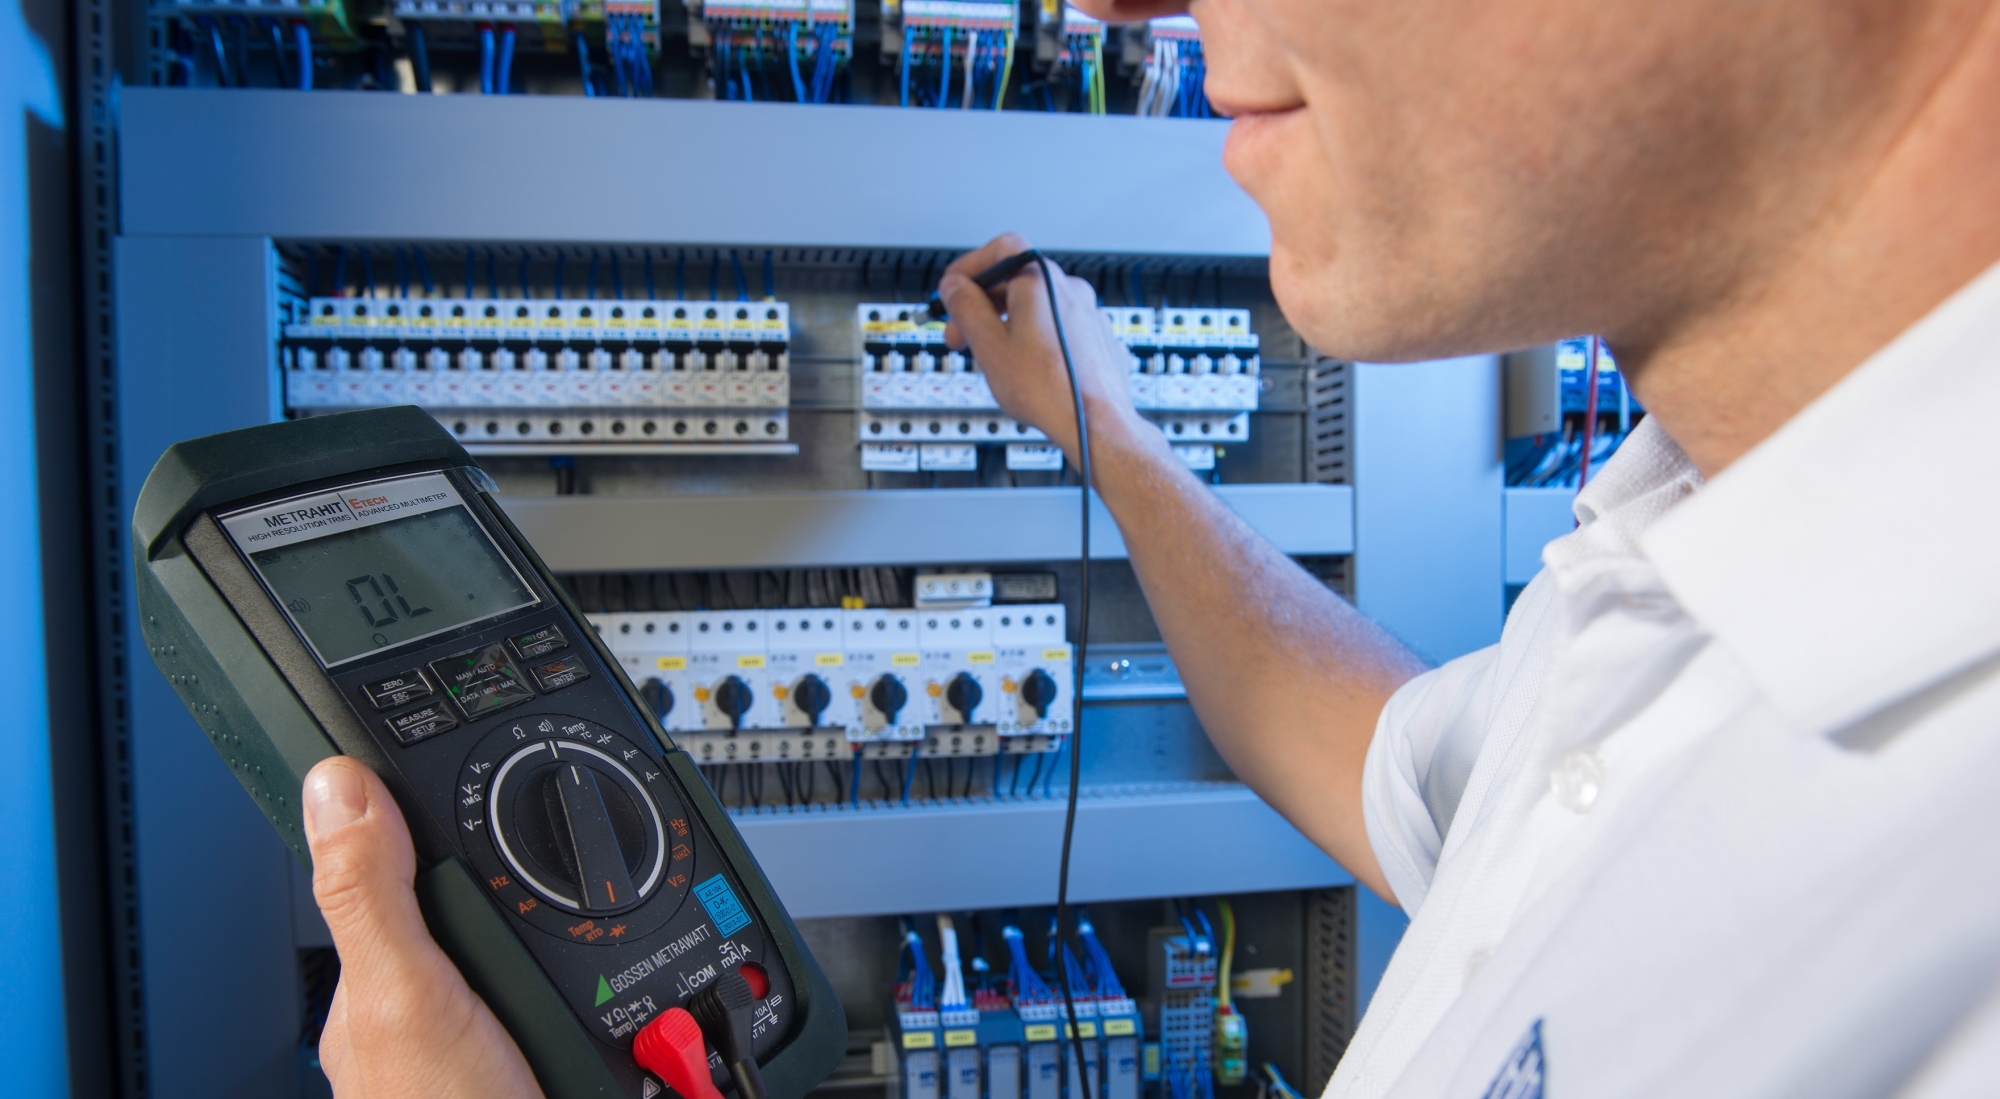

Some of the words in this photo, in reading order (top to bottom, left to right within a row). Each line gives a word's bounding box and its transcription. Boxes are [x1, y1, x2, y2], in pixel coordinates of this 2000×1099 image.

[358, 503, 401, 518] ADVANCED
[399, 492, 448, 508] MULTIMETER
[263, 502, 343, 528] METRAHIT
[248, 532, 272, 542] HIGH
[272, 519, 327, 537] RESOLUTION
[327, 514, 352, 524] TRMS
[536, 629, 549, 639] OFF
[532, 641, 553, 655] LIGHT
[455, 671, 473, 682] MAN
[476, 663, 496, 675] AUTO
[552, 672, 576, 686] ENTER
[381, 679, 404, 691] ZERO
[460, 692, 481, 704] DATA
[482, 684, 498, 696] MIN
[500, 679, 517, 690] MAX
[391, 691, 410, 702] ESC
[396, 708, 435, 727] MEASURE
[411, 722, 436, 737] SETUP
[561, 722, 586, 736] Temp
[580, 731, 592, 740] TC
[669, 818, 687, 831] Hz
[677, 827, 688, 837] dB
[490, 875, 510, 890] Hz
[567, 920, 595, 938] Temp
[723, 915, 744, 931] 2013-01
[585, 927, 604, 942] RTD
[610, 958, 655, 993] GOSSEN
[650, 923, 711, 969] METRAWATT
[688, 964, 717, 988] COM
[754, 1005, 769, 1018] 10A
[608, 1020, 633, 1039] Temp
